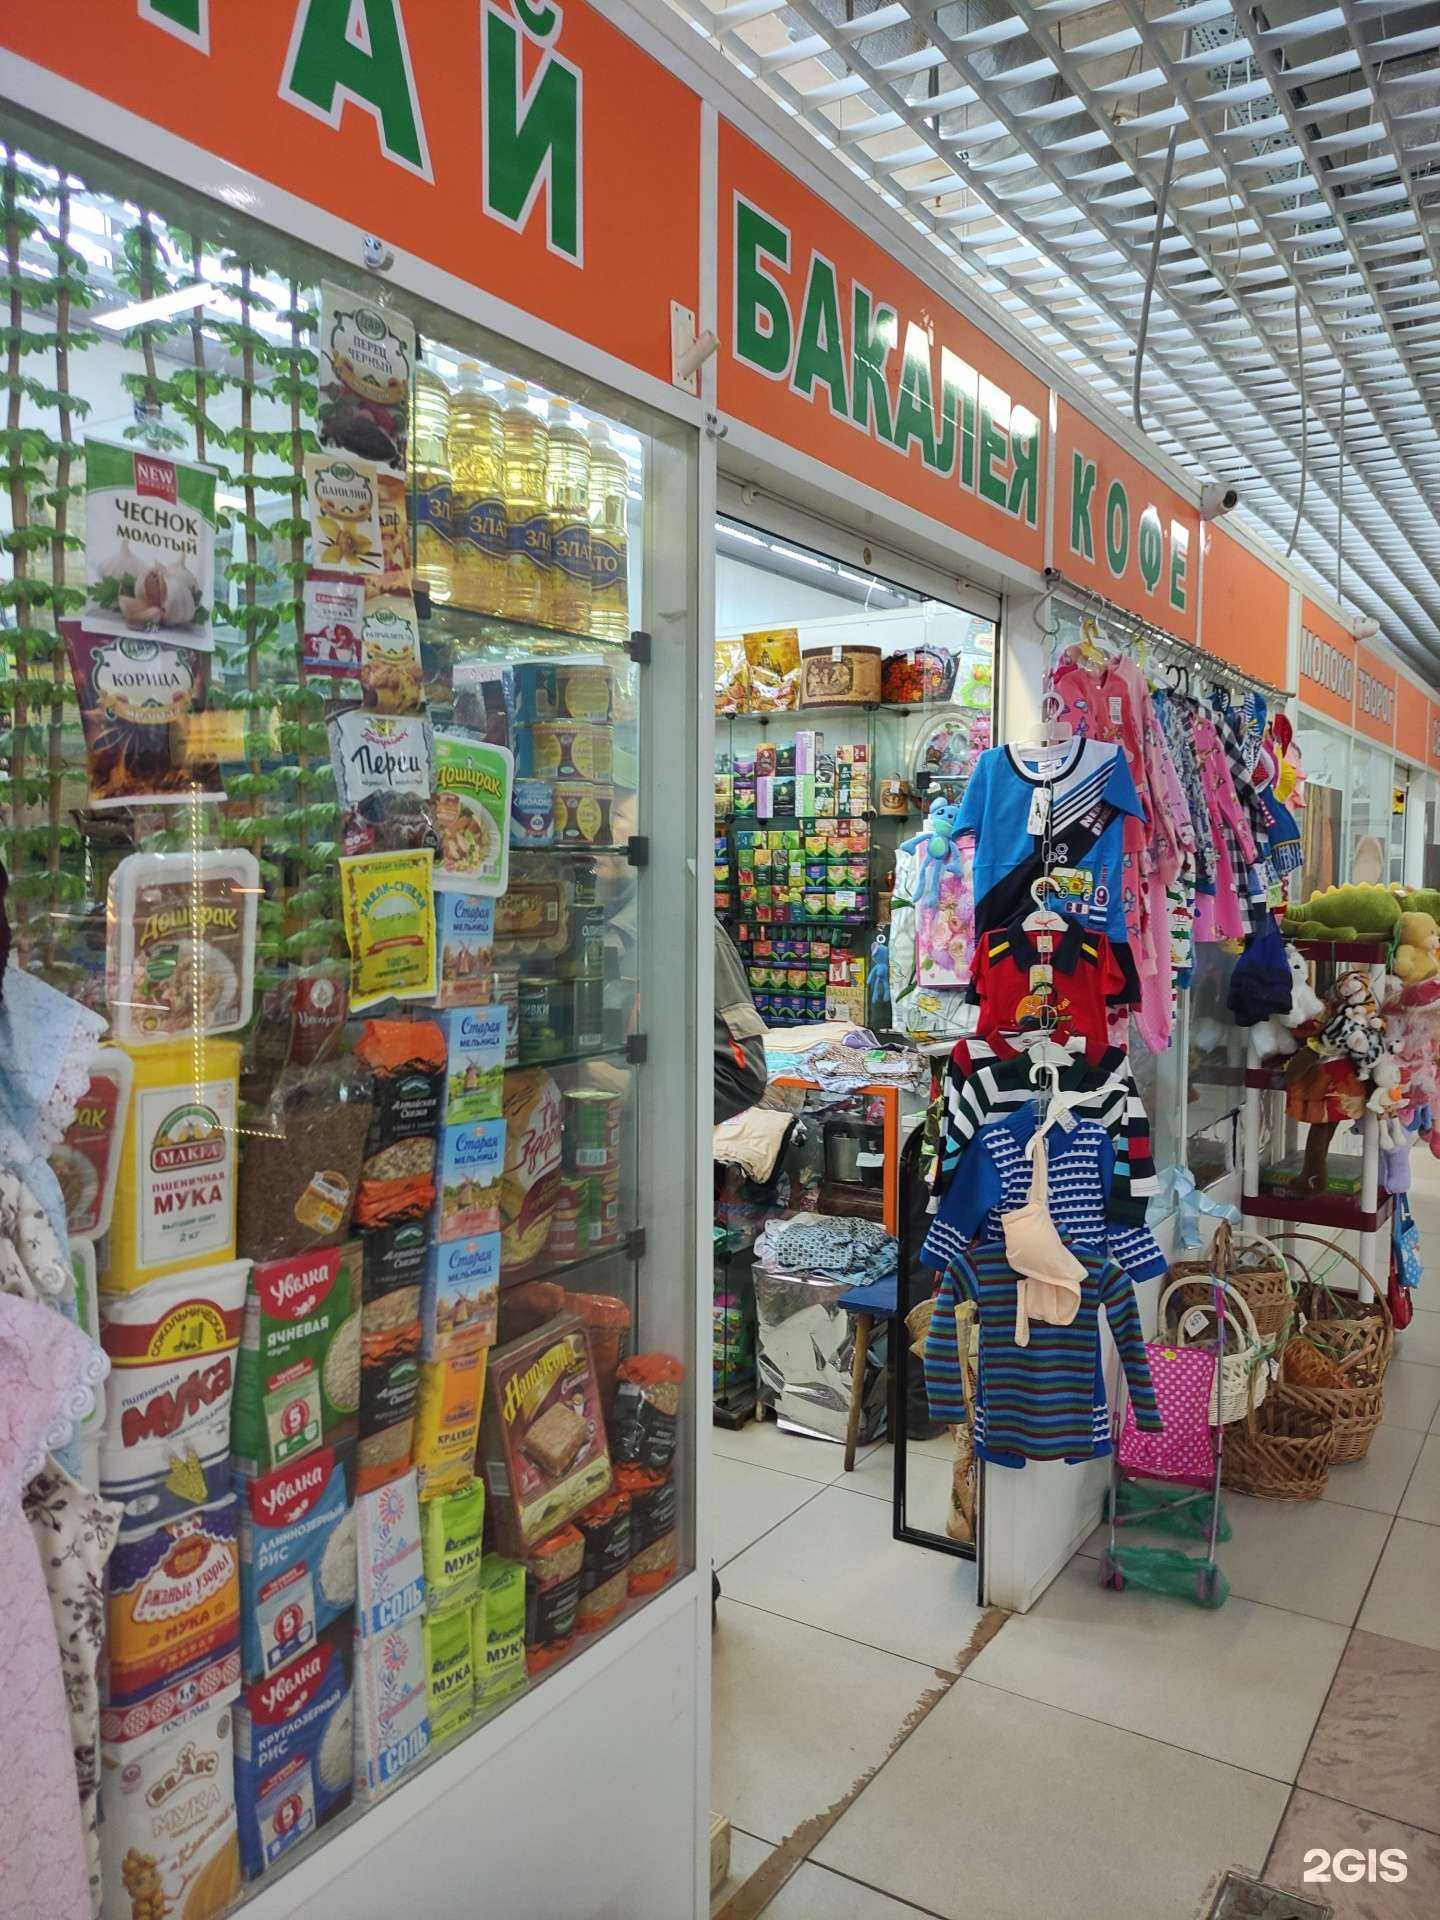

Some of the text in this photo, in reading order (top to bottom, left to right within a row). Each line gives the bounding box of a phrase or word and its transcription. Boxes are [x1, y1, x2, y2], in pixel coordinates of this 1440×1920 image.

[138, 0, 583, 269] АЙ
[348, 347, 393, 375] ЧЕРНЫЙ
[353, 335, 390, 364] ПЕРЕЦ
[732, 188, 1042, 530] БАКАЛЕЯ
[137, 462, 174, 484] NEW
[115, 498, 198, 536] ЧЕСНОК
[430, 498, 452, 521] ЗЛ
[116, 524, 198, 555] МОЛОТЫЙ
[1069, 447, 1190, 613] КОФЕ
[1301, 625, 1354, 702] МОЛОКО
[112, 671, 182, 689] КОРИЦА
[454, 899, 489, 922] Старая
[461, 1016, 500, 1039] Старая
[455, 1132, 499, 1152] Старая
[453, 1152, 498, 1166] мельница
[152, 1171, 226, 1193] ПШЕНИЧНАЯ
[153, 1184, 223, 1216] МУКА
[449, 1250, 493, 1270] Старая
[270, 1265, 329, 1307] Увелка
[267, 1315, 329, 1347] ЯЧНЕВАЯ
[261, 1466, 323, 1516] Увелка
[258, 1502, 346, 1555] ДЛИННОЗЕРНЫЙ
[258, 1547, 290, 1572] РИС
[444, 1546, 481, 1574] МУКА
[379, 1577, 423, 1627] СОЛЬ
[165, 1611, 210, 1641] МУКА
[261, 1657, 322, 1713] Увелка
[432, 1663, 471, 1695] МУКА
[258, 1689, 342, 1753] КРУГЛОЗЕРНЫЙ
[258, 1740, 289, 1769] РИС
[385, 1725, 429, 1776] СОЛЬ
